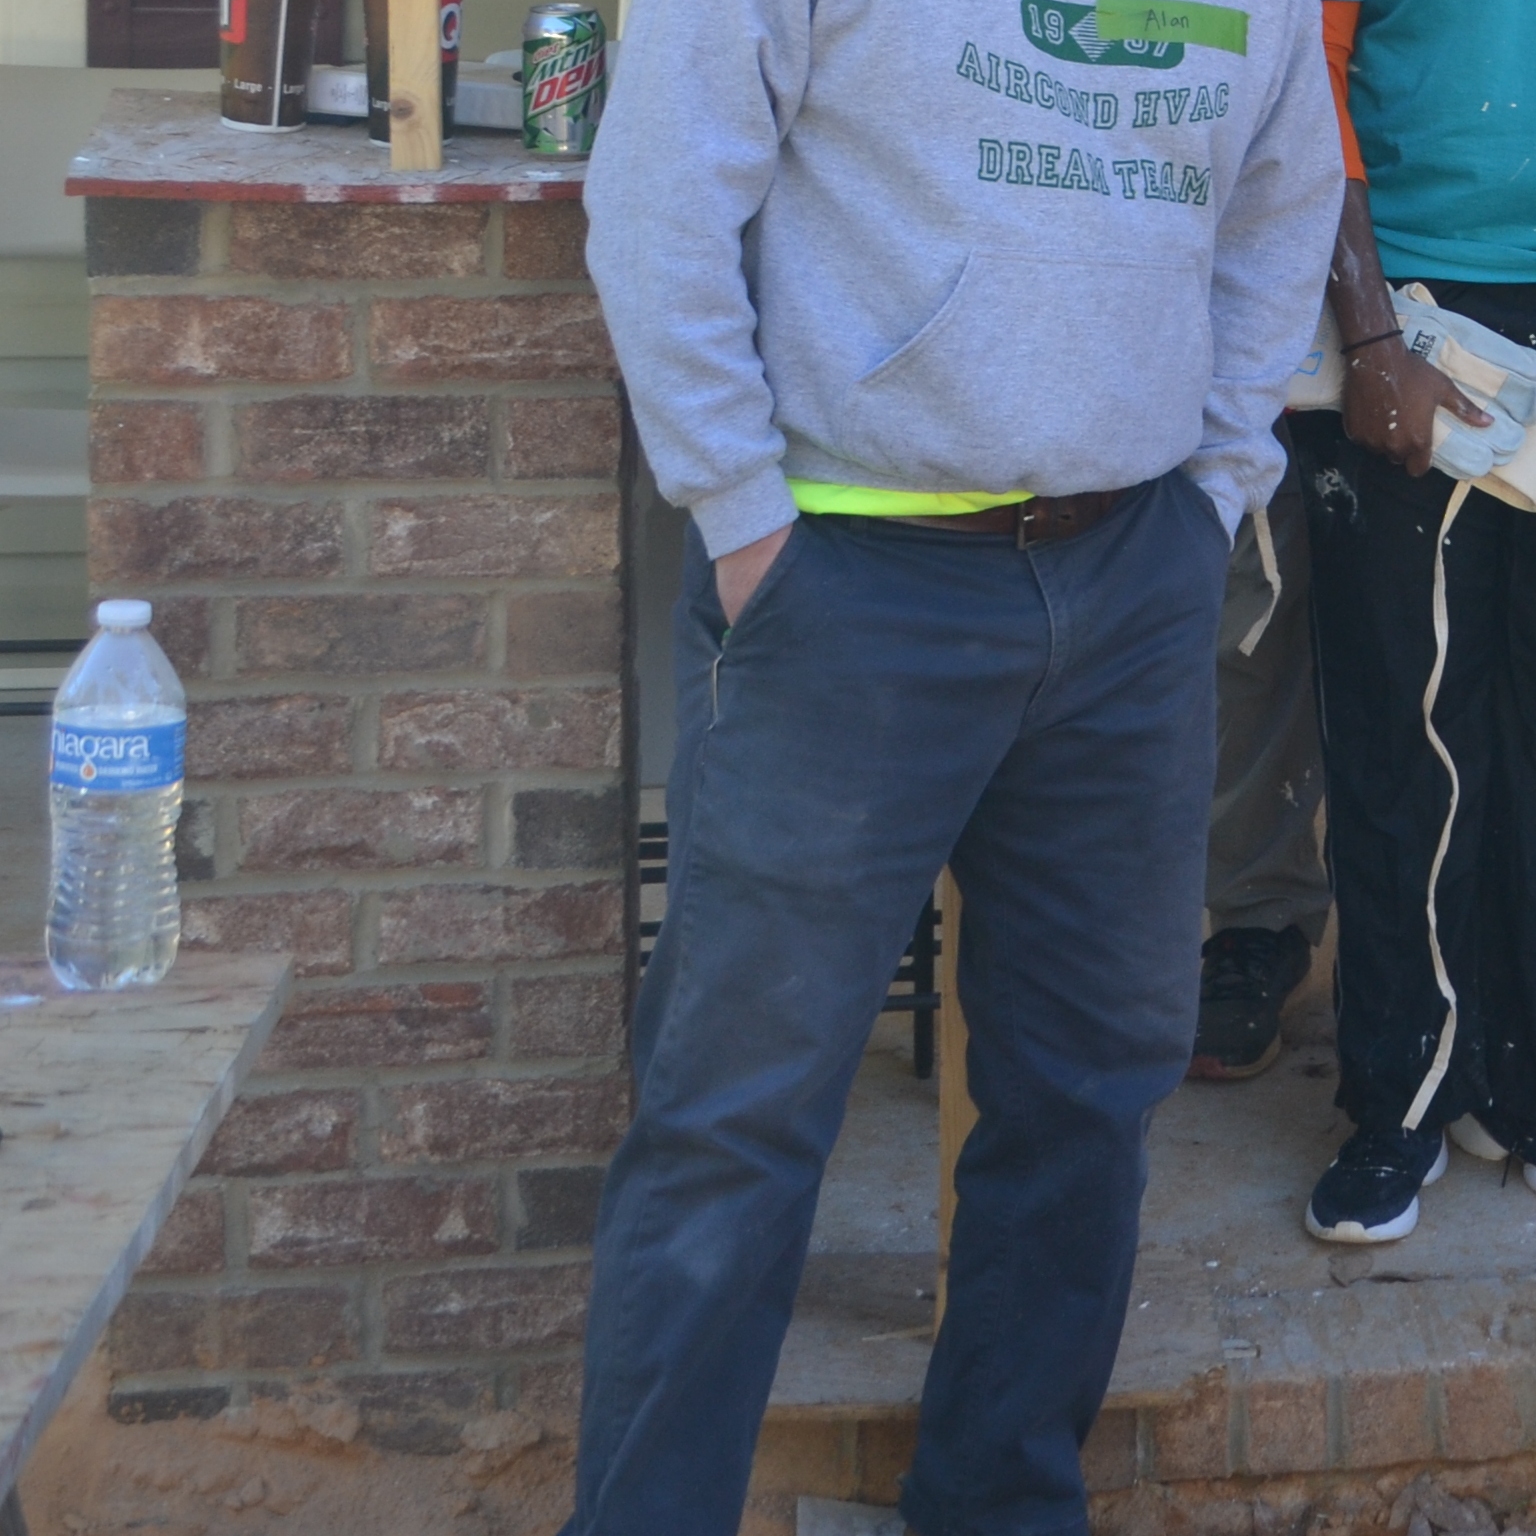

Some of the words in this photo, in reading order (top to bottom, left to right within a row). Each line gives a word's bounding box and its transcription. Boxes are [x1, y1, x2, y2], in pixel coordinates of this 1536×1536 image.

[1144, 8, 1190, 32] Alan
[234, 78, 263, 94] Large
[956, 41, 1119, 131] AIRCOND
[1132, 82, 1231, 129] HVAC
[977, 137, 1111, 197] DREAM
[1113, 158, 1212, 206] TEAM
[51, 728, 151, 764] niagara
